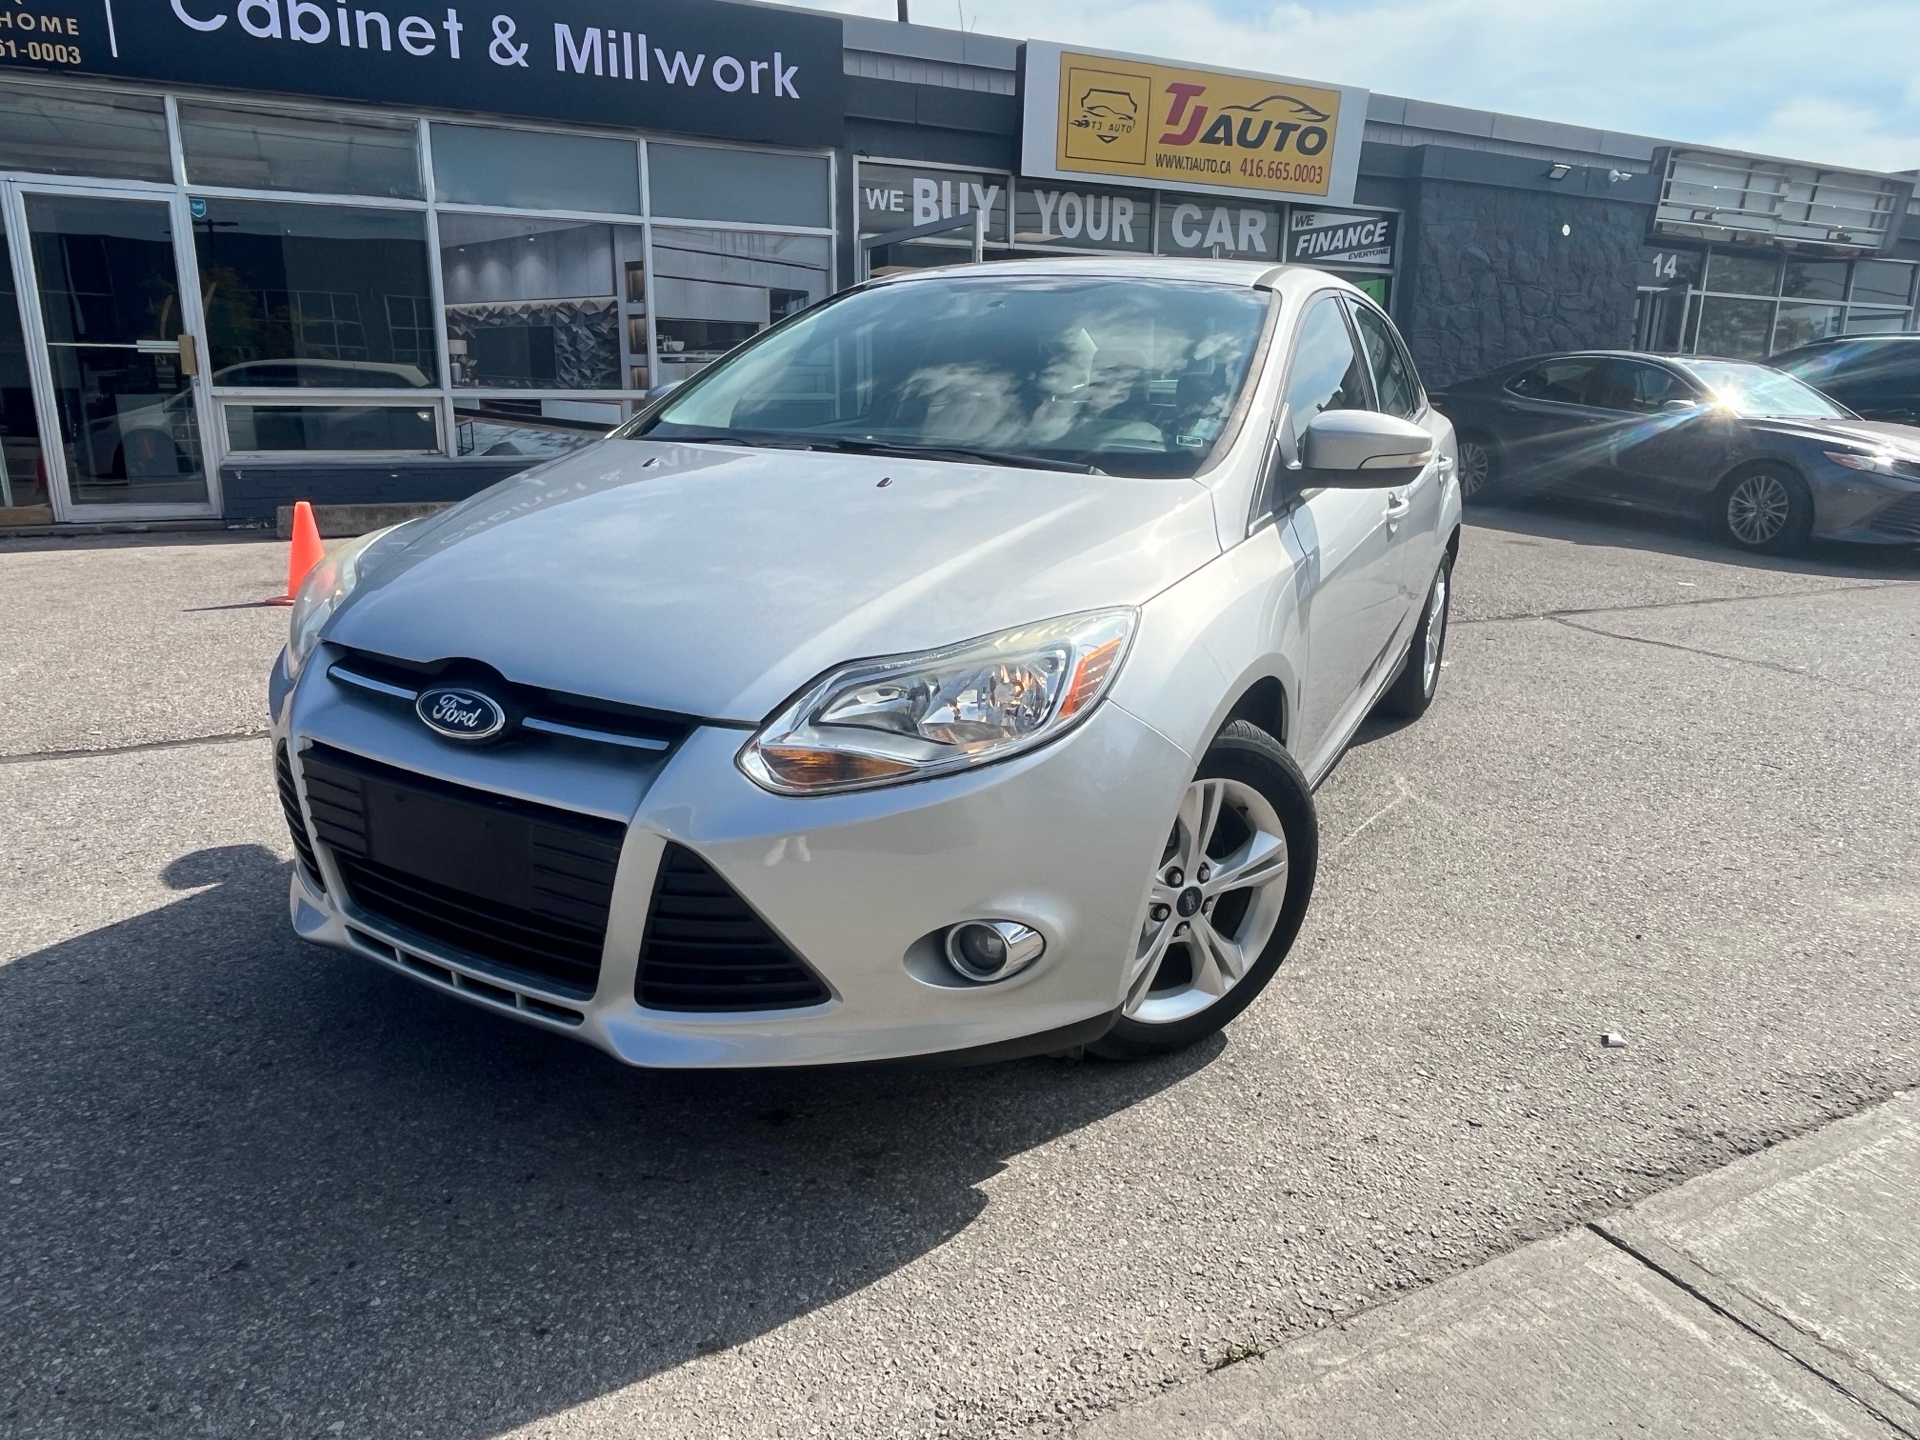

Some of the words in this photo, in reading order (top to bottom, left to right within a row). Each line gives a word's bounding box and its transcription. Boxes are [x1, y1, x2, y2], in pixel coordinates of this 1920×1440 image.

[0, 11, 79, 36] HOME
[170, 0, 464, 59] Cabinet
[488, 14, 530, 67] &
[553, 23, 800, 99] Millwork
[1108, 123, 1132, 134] AUTO
[1155, 153, 1231, 175] WWW.TJAUTO.CA
[1240, 157, 1323, 184] 416.665.0003
[866, 188, 905, 212] WE
[913, 178, 999, 233] BUY
[1034, 189, 1135, 243] YOUR
[1171, 203, 1267, 252] CAR
[1295, 214, 1315, 228] WE
[1296, 221, 1389, 257] FINANCE
[1348, 247, 1389, 260] EVERYONE
[1652, 252, 1677, 279] 14
[432, 694, 482, 728] Ford
